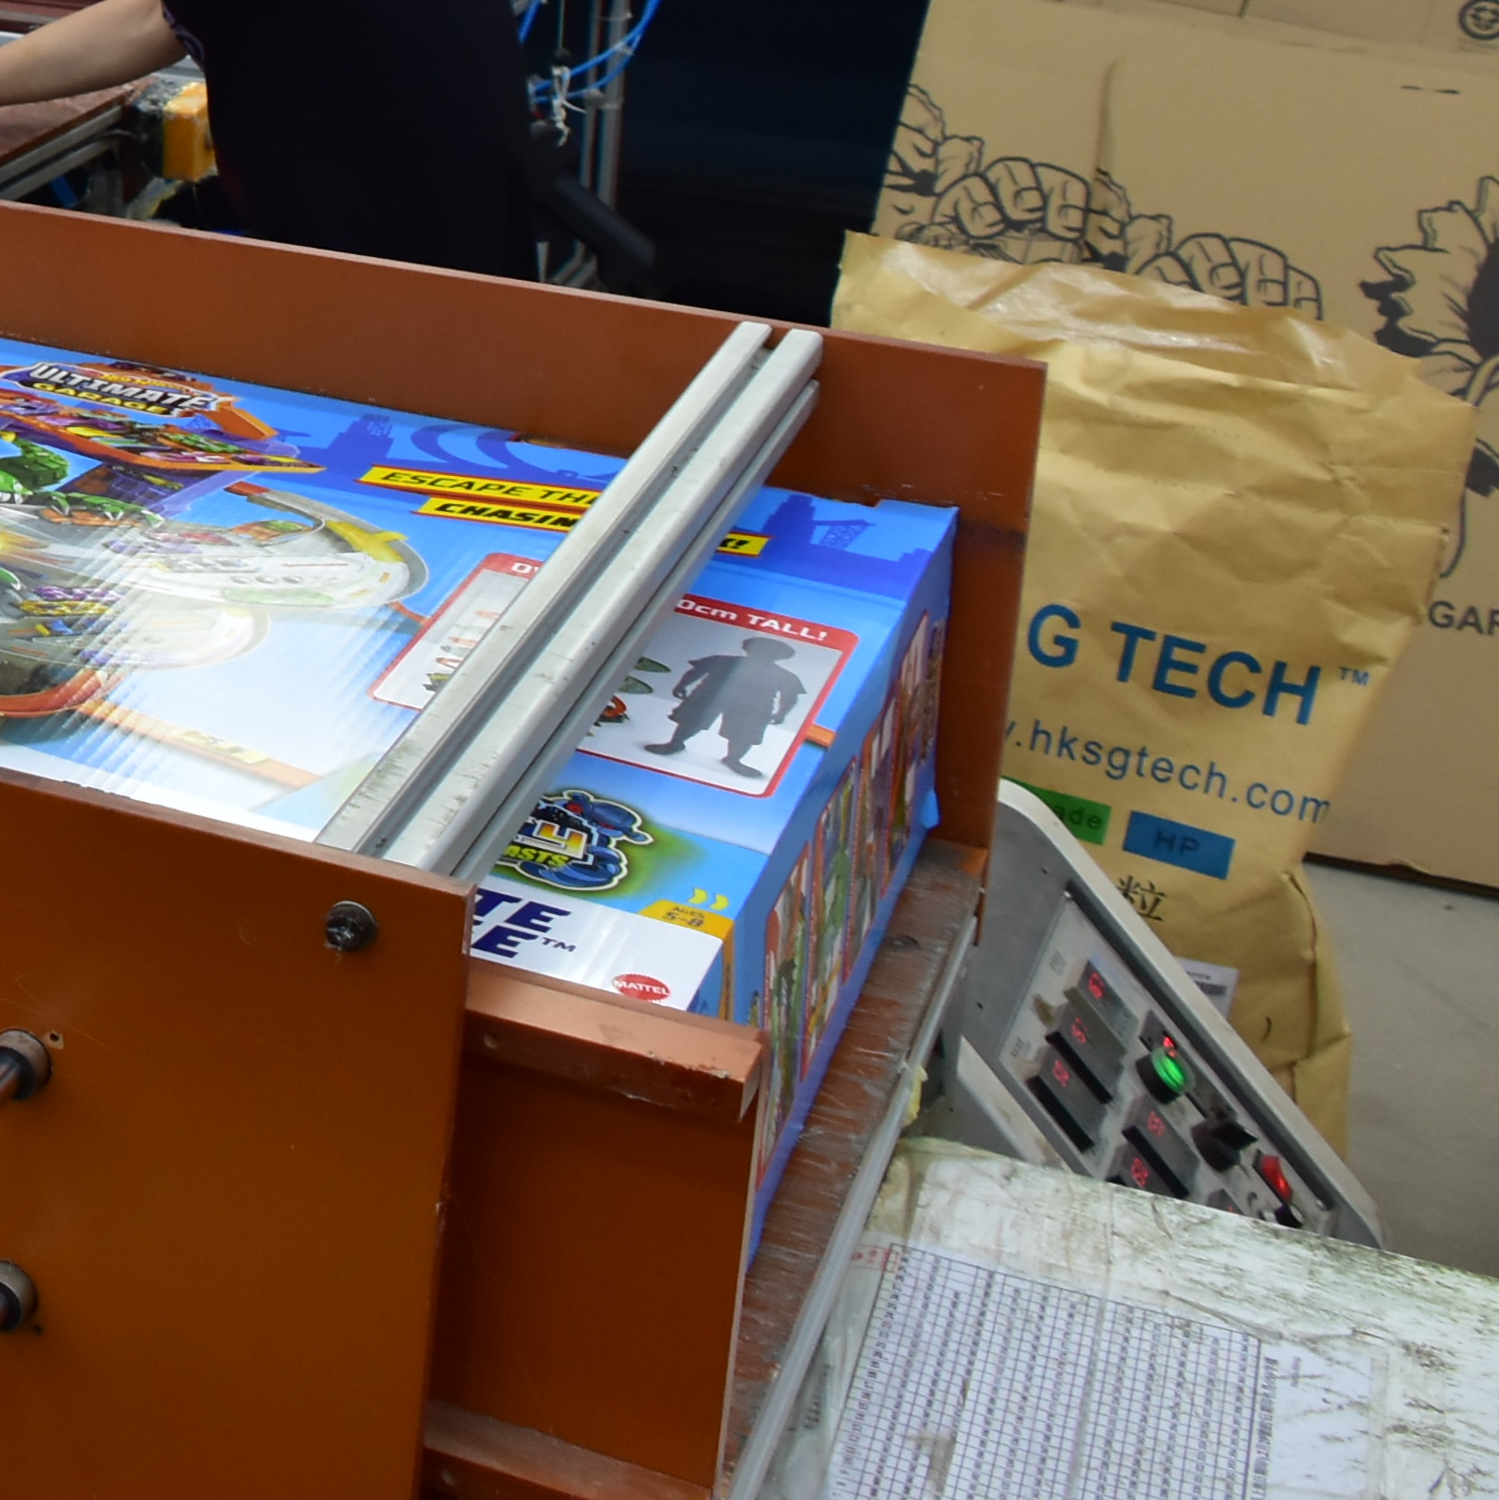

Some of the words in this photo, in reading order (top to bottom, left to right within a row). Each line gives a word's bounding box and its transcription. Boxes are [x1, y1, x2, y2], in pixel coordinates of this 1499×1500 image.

[29, 362, 212, 409] ULTIMATE
[32, 382, 169, 415] GARAGE
[381, 471, 532, 497] ESCAPE
[746, 613, 829, 642] TALL!
[1027, 603, 1082, 669] G
[1110, 621, 1322, 726] TECH
[1153, 829, 1200, 856] HP
[613, 976, 671, 997] MATTEL
